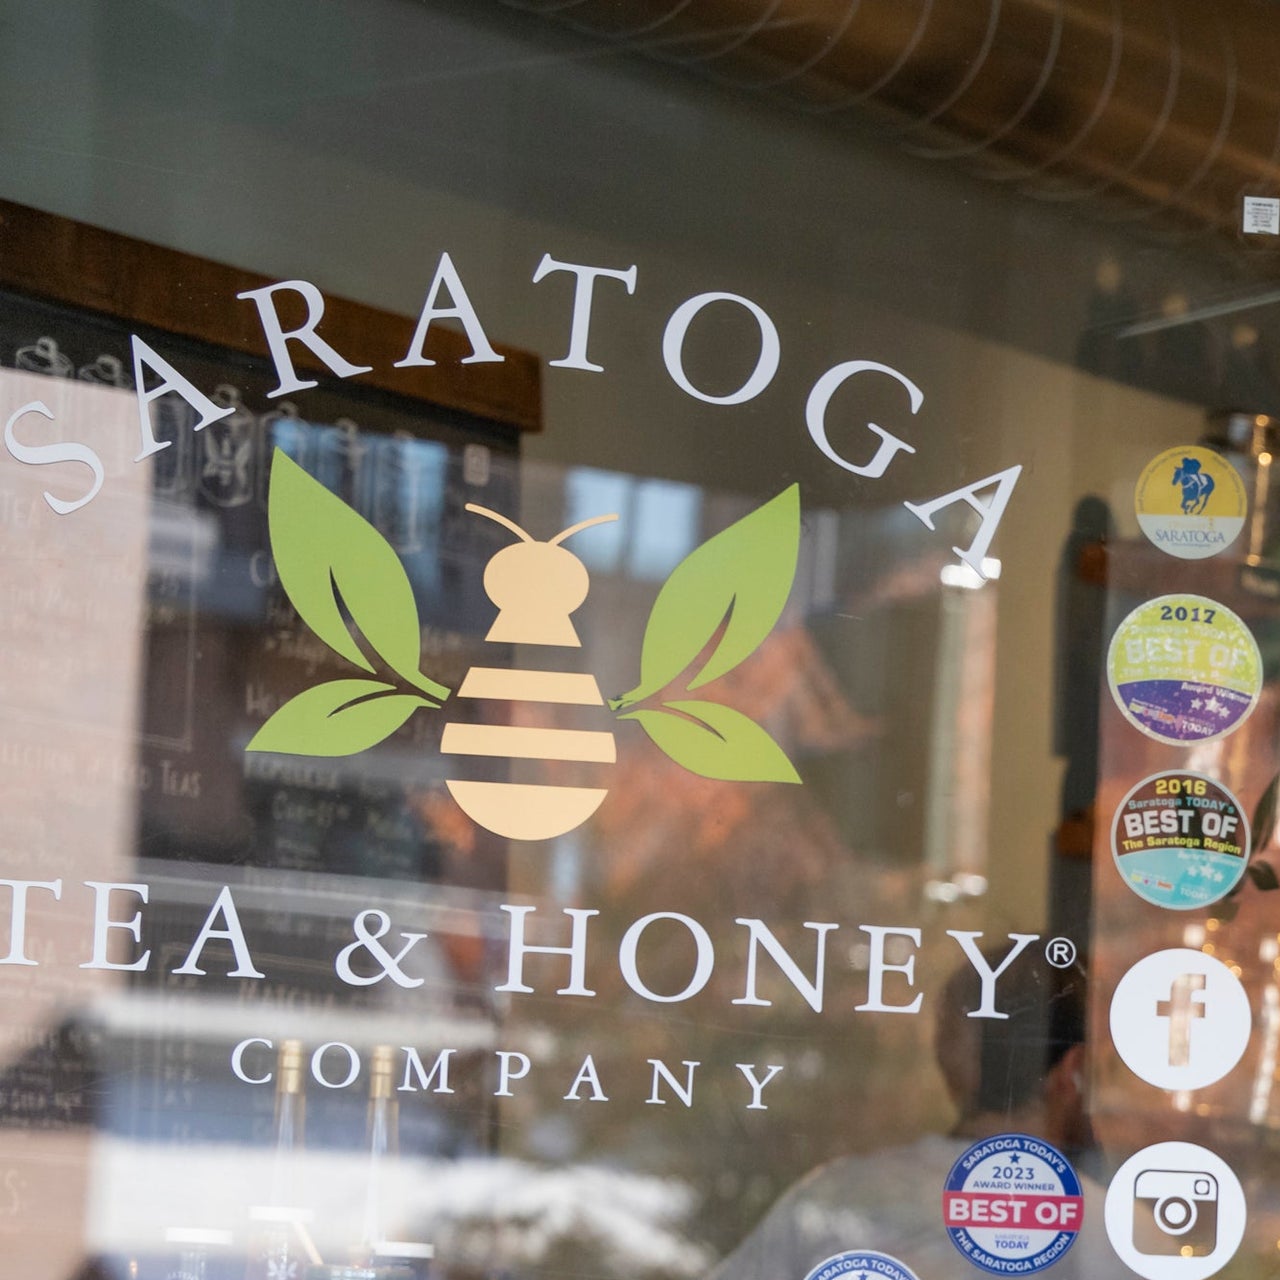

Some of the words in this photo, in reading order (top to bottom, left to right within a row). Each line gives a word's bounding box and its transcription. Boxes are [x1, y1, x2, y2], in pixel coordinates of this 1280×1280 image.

[4, 252, 1022, 579] SARATOGA
[1156, 529, 1226, 544] SARATOGA
[1160, 606, 1216, 624] 2017
[1125, 638, 1200, 664] BEST
[1209, 643, 1248, 670] OF
[1182, 721, 1214, 735] TODAY
[1155, 779, 1206, 795] 2016
[1128, 798, 1182, 810] Saratoga
[1186, 797, 1235, 814] TODAY's
[1124, 809, 1194, 838] BEST
[1201, 812, 1238, 839] OF
[1122, 839, 1144, 850] The
[1146, 836, 1200, 847] Saratoga
[1204, 837, 1242, 854] Region
[0, 878, 266, 979] TEA
[334, 908, 428, 988] &
[230, 1037, 784, 1110] COMPANY
[962, 1139, 1020, 1170] SARATOGA
[1022, 1140, 1066, 1173] TODAY'S
[992, 1166, 1034, 1180] 2023
[973, 1181, 1011, 1189] AWARD
[1014, 1182, 1055, 1191] WINNER
[949, 1198, 1027, 1223] BEST
[1035, 1201, 1078, 1225] OF
[955, 1230, 973, 1252] THE
[971, 1249, 1032, 1272] SARATOGA
[1033, 1233, 1070, 1267] REGION
[996, 1241, 1029, 1249] TODAY
